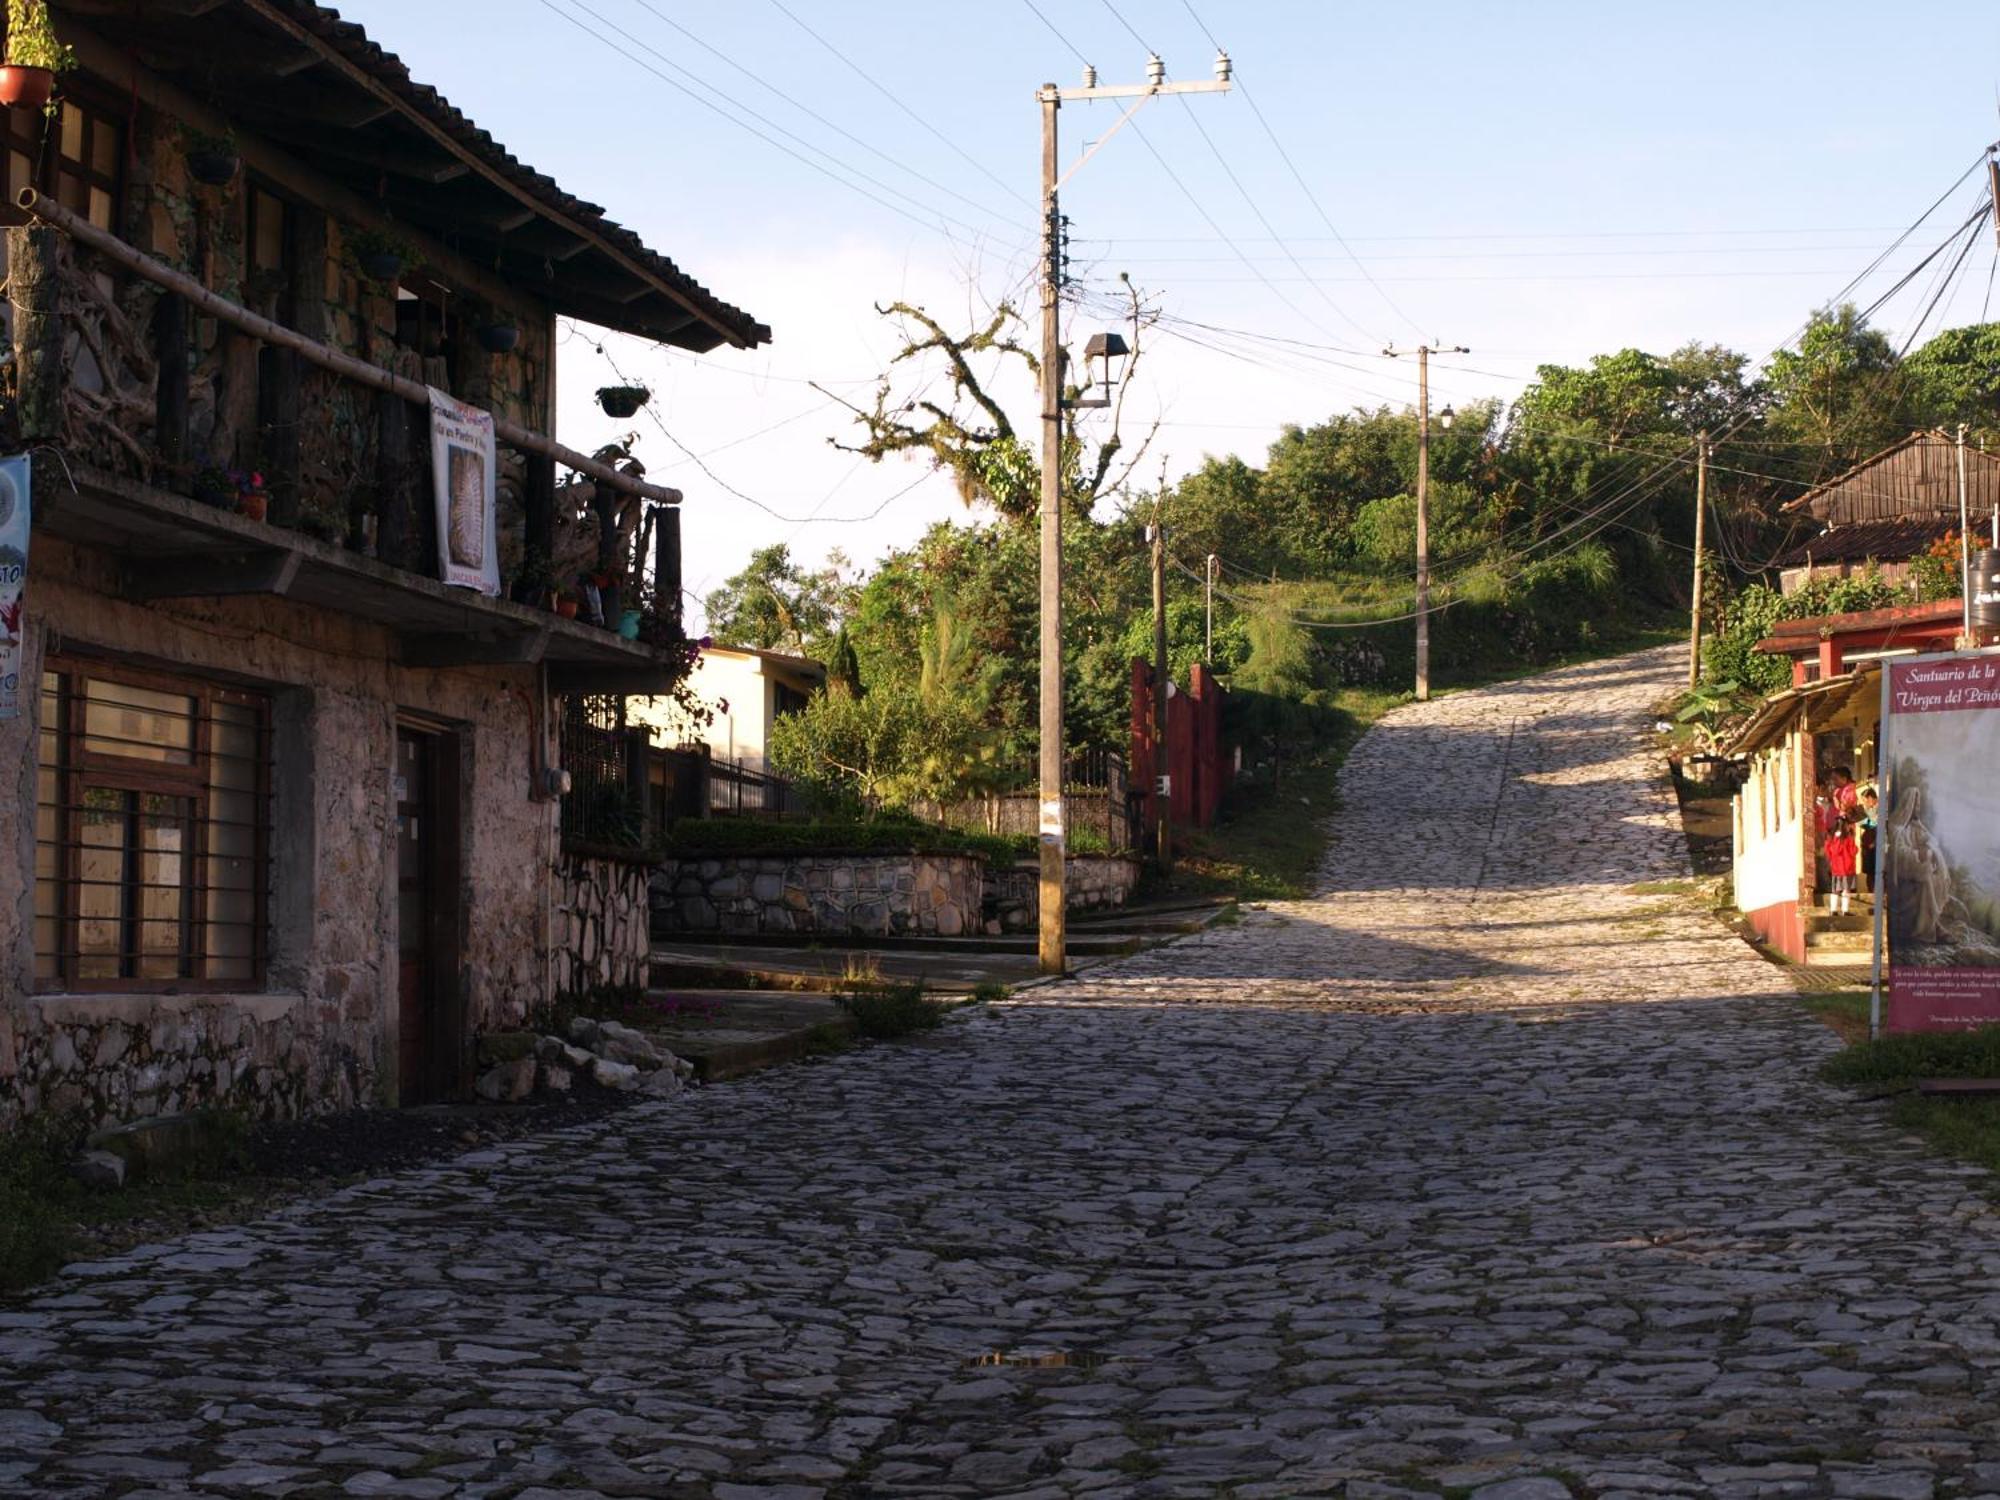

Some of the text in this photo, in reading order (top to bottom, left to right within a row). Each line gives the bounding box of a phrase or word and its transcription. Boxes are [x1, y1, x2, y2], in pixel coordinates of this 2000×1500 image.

[1905, 663, 1996, 684] Santuario de la
[1896, 692, 1942, 711] Virgen
[1945, 689, 1962, 703] del
